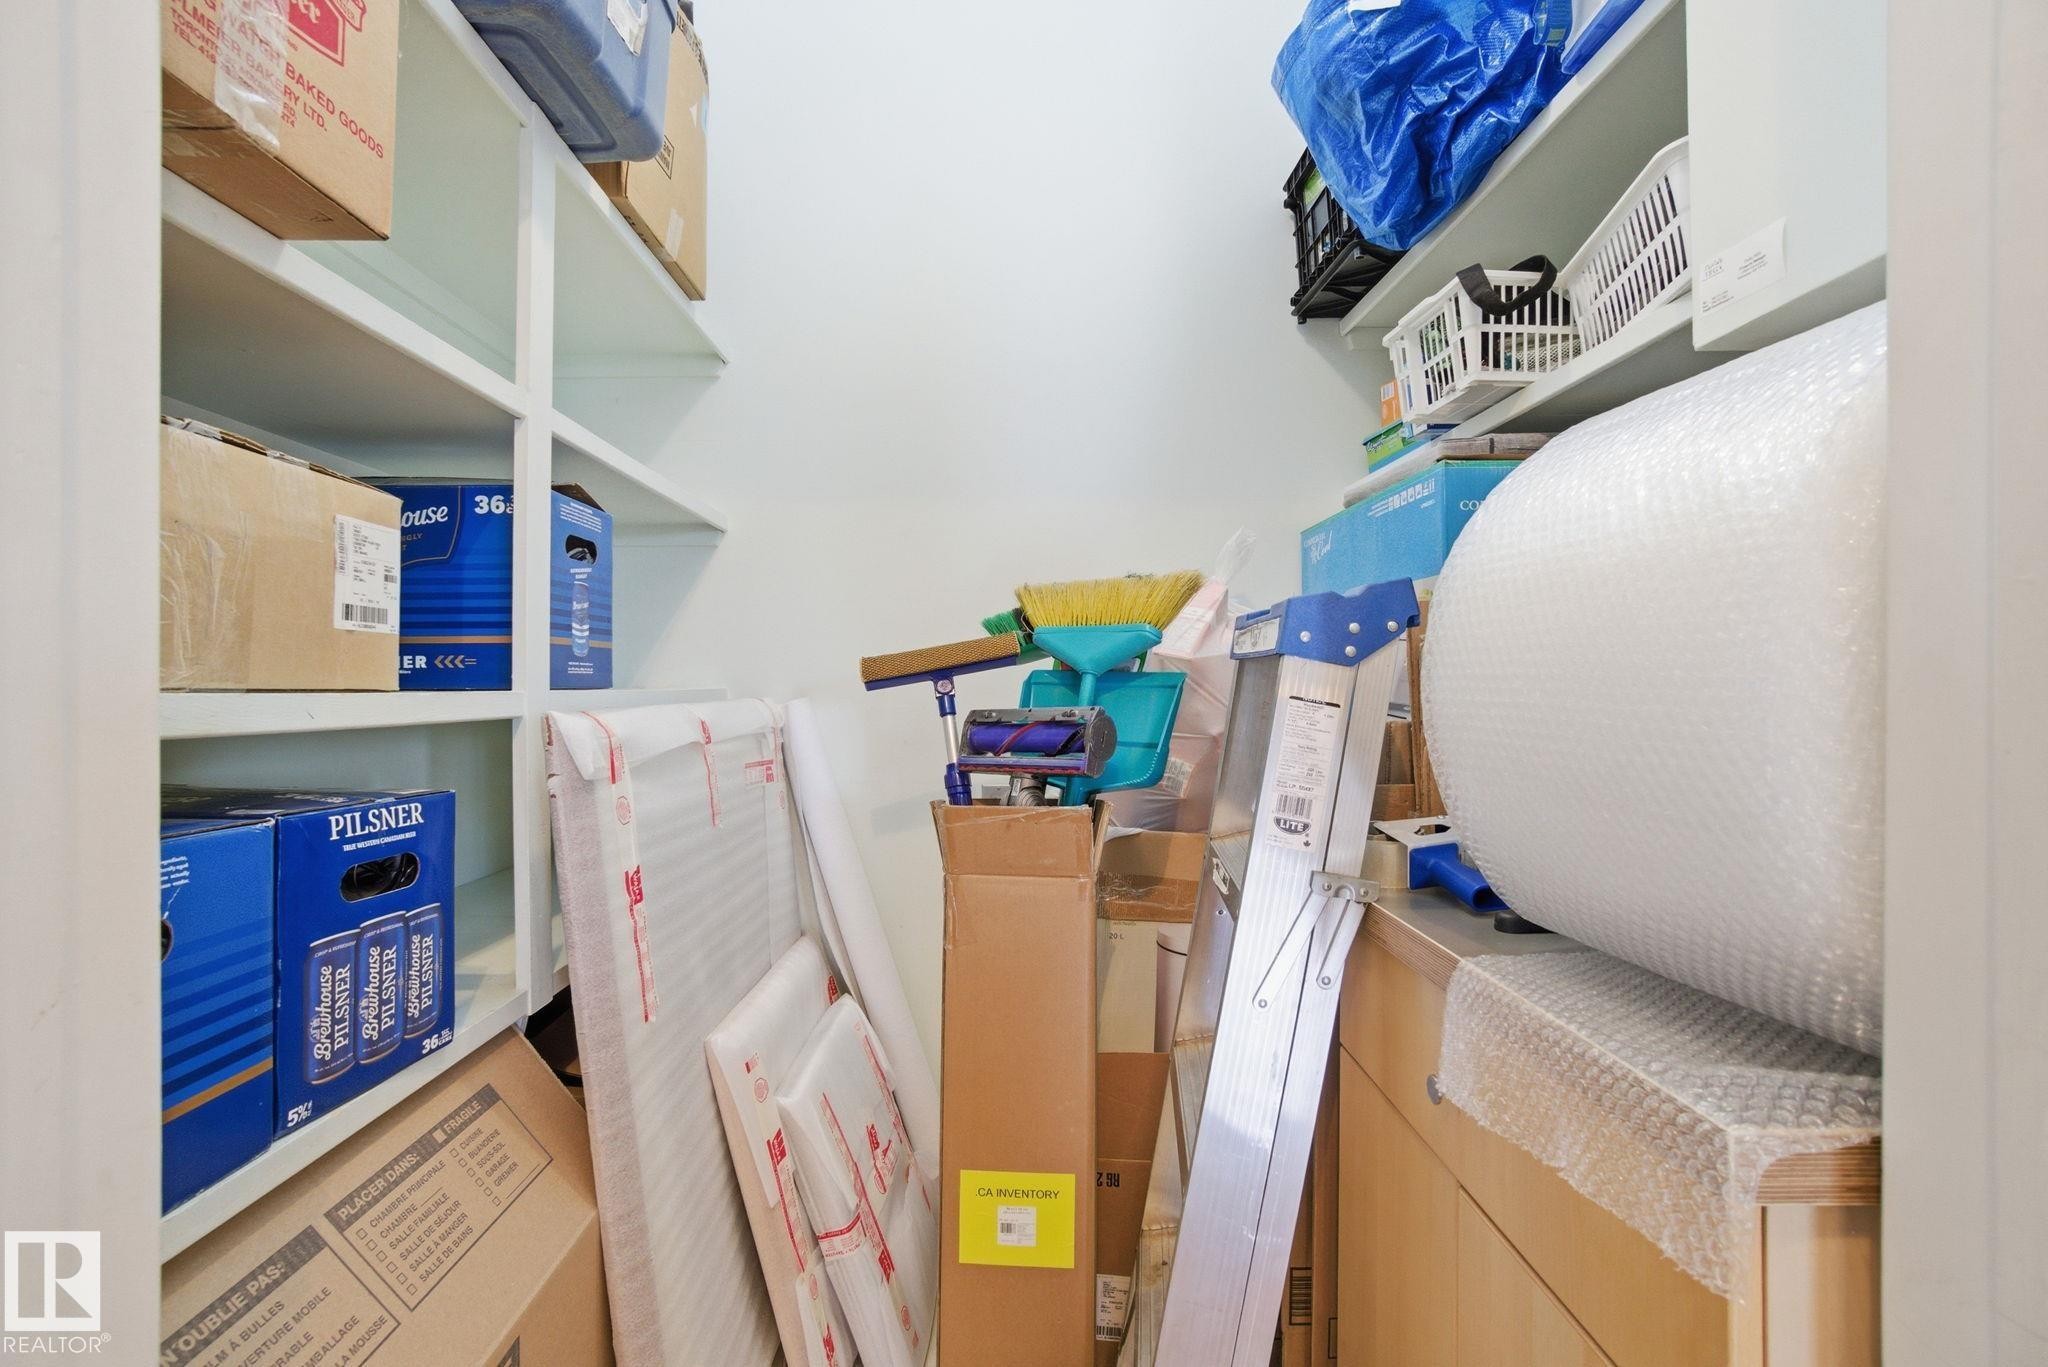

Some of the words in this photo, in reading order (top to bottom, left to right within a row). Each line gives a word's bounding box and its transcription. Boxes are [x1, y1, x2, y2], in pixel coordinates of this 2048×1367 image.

[285, 62, 336, 116] BAKED
[339, 110, 384, 159] GOODS
[304, 103, 328, 132] LTD.
[475, 495, 506, 515] 36
[1460, 500, 1482, 511] CO
[399, 655, 427, 669] ER
[328, 803, 424, 840] PILSNER
[1280, 818, 1304, 831] LITE
[381, 945, 397, 1032] PILSNER
[407, 934, 421, 1018] Brewhouse
[421, 933, 434, 1010] PILSNER
[314, 965, 333, 1061] Brewhouse
[334, 964, 351, 1052] PILSNER
[362, 946, 381, 1041] Brewhouse
[422, 1033, 439, 1054] 36
[443, 1100, 482, 1134] FRAGILE
[476, 1142, 506, 1168] SOUS-SOL
[485, 1152, 511, 1178] GARAGE
[337, 1178, 388, 1222] PLACER
[385, 1151, 421, 1183] DANS:
[369, 1193, 409, 1228] CHAMBRE
[406, 1161, 447, 1196] PRINCIPALE
[996, 1188, 1060, 1200] INVENTORY
[379, 1203, 419, 1239] CHAMBRE
[389, 1224, 416, 1250] SALLE
[413, 1192, 450, 1228] FAMILIALE
[399, 1235, 426, 1261] SALLE
[423, 1225, 437, 1238] DE
[409, 1246, 435, 1272] SALLE
[434, 1240, 441, 1250] À
[438, 1212, 469, 1242] MANGER
[419, 1256, 445, 1282] SALLE
[442, 1245, 455, 1259] DE
[452, 1225, 474, 1249] BAINS
[247, 1262, 286, 1297] PAS:
[292, 1286, 332, 1325] MOBILE
[229, 1339, 241, 1352] À
[239, 1300, 286, 1342] BULLES
[348, 1314, 389, 1356] MOUSSE
